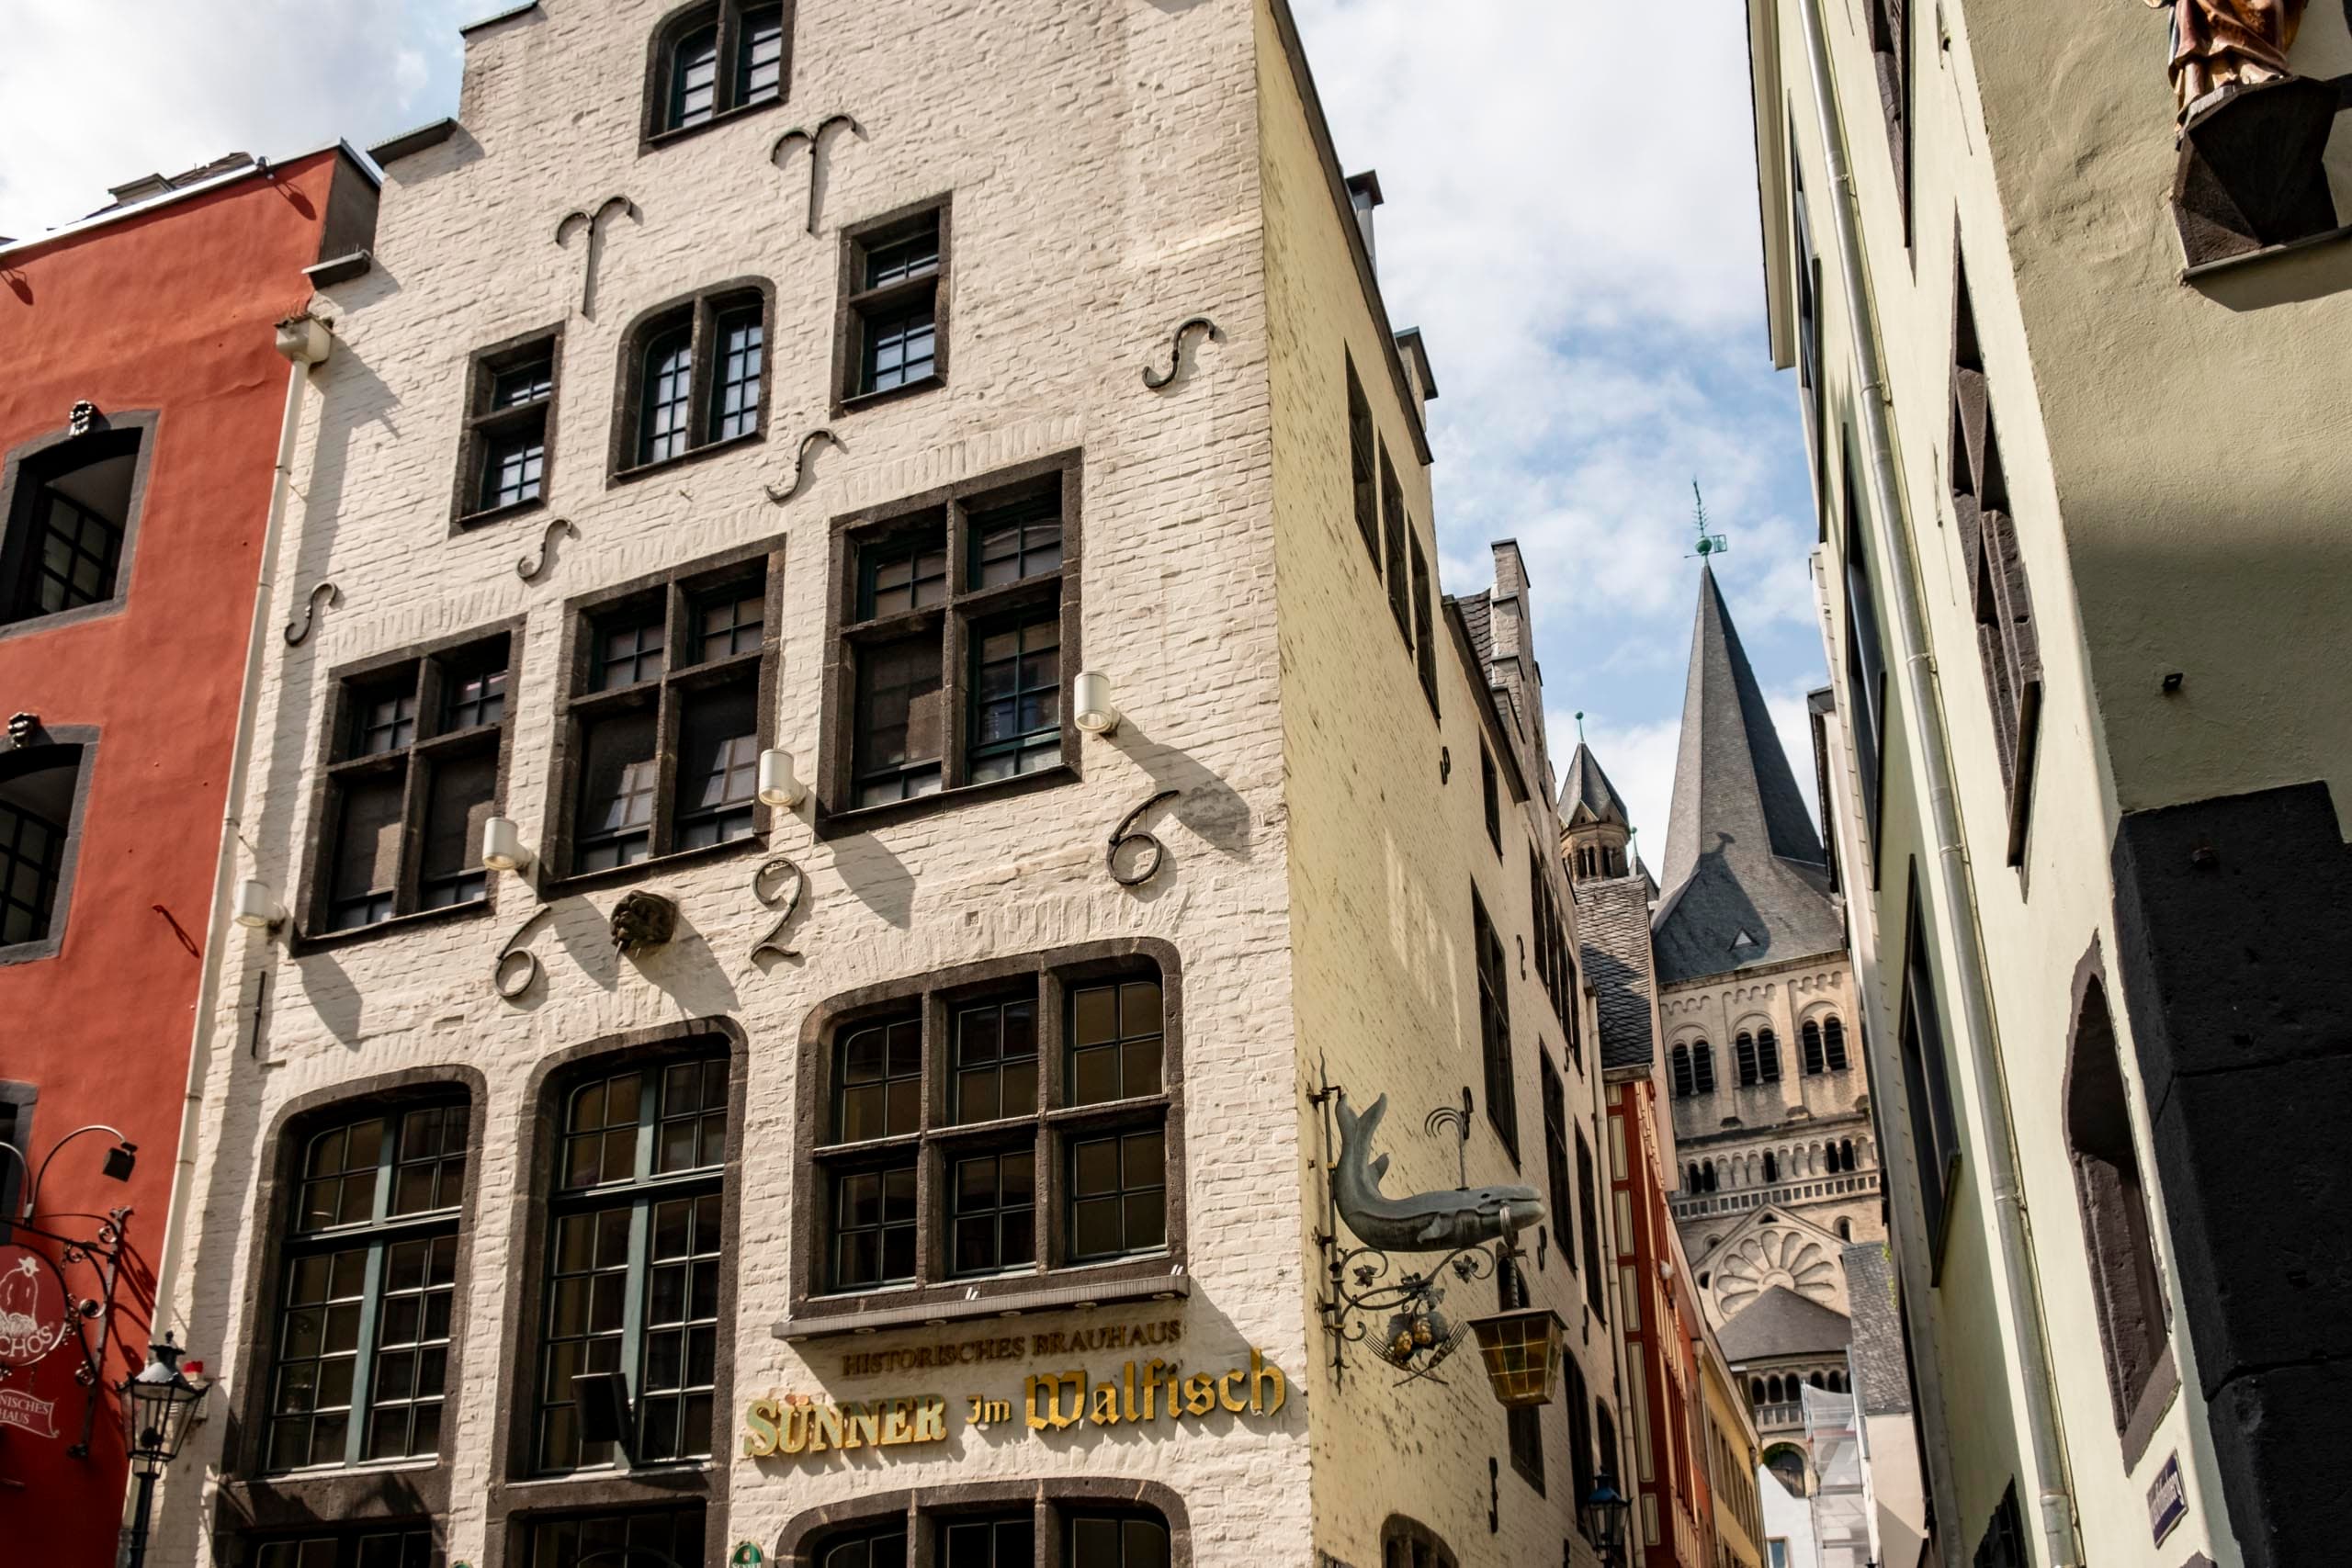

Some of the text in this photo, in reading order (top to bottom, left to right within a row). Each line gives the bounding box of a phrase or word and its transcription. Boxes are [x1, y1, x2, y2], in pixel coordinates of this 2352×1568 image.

[842, 1318, 1182, 1377] HISTORISCHES BRAUHAUS
[743, 1393, 948, 1457] SÜNNER
[1024, 1346, 1286, 1431] Walfisch
